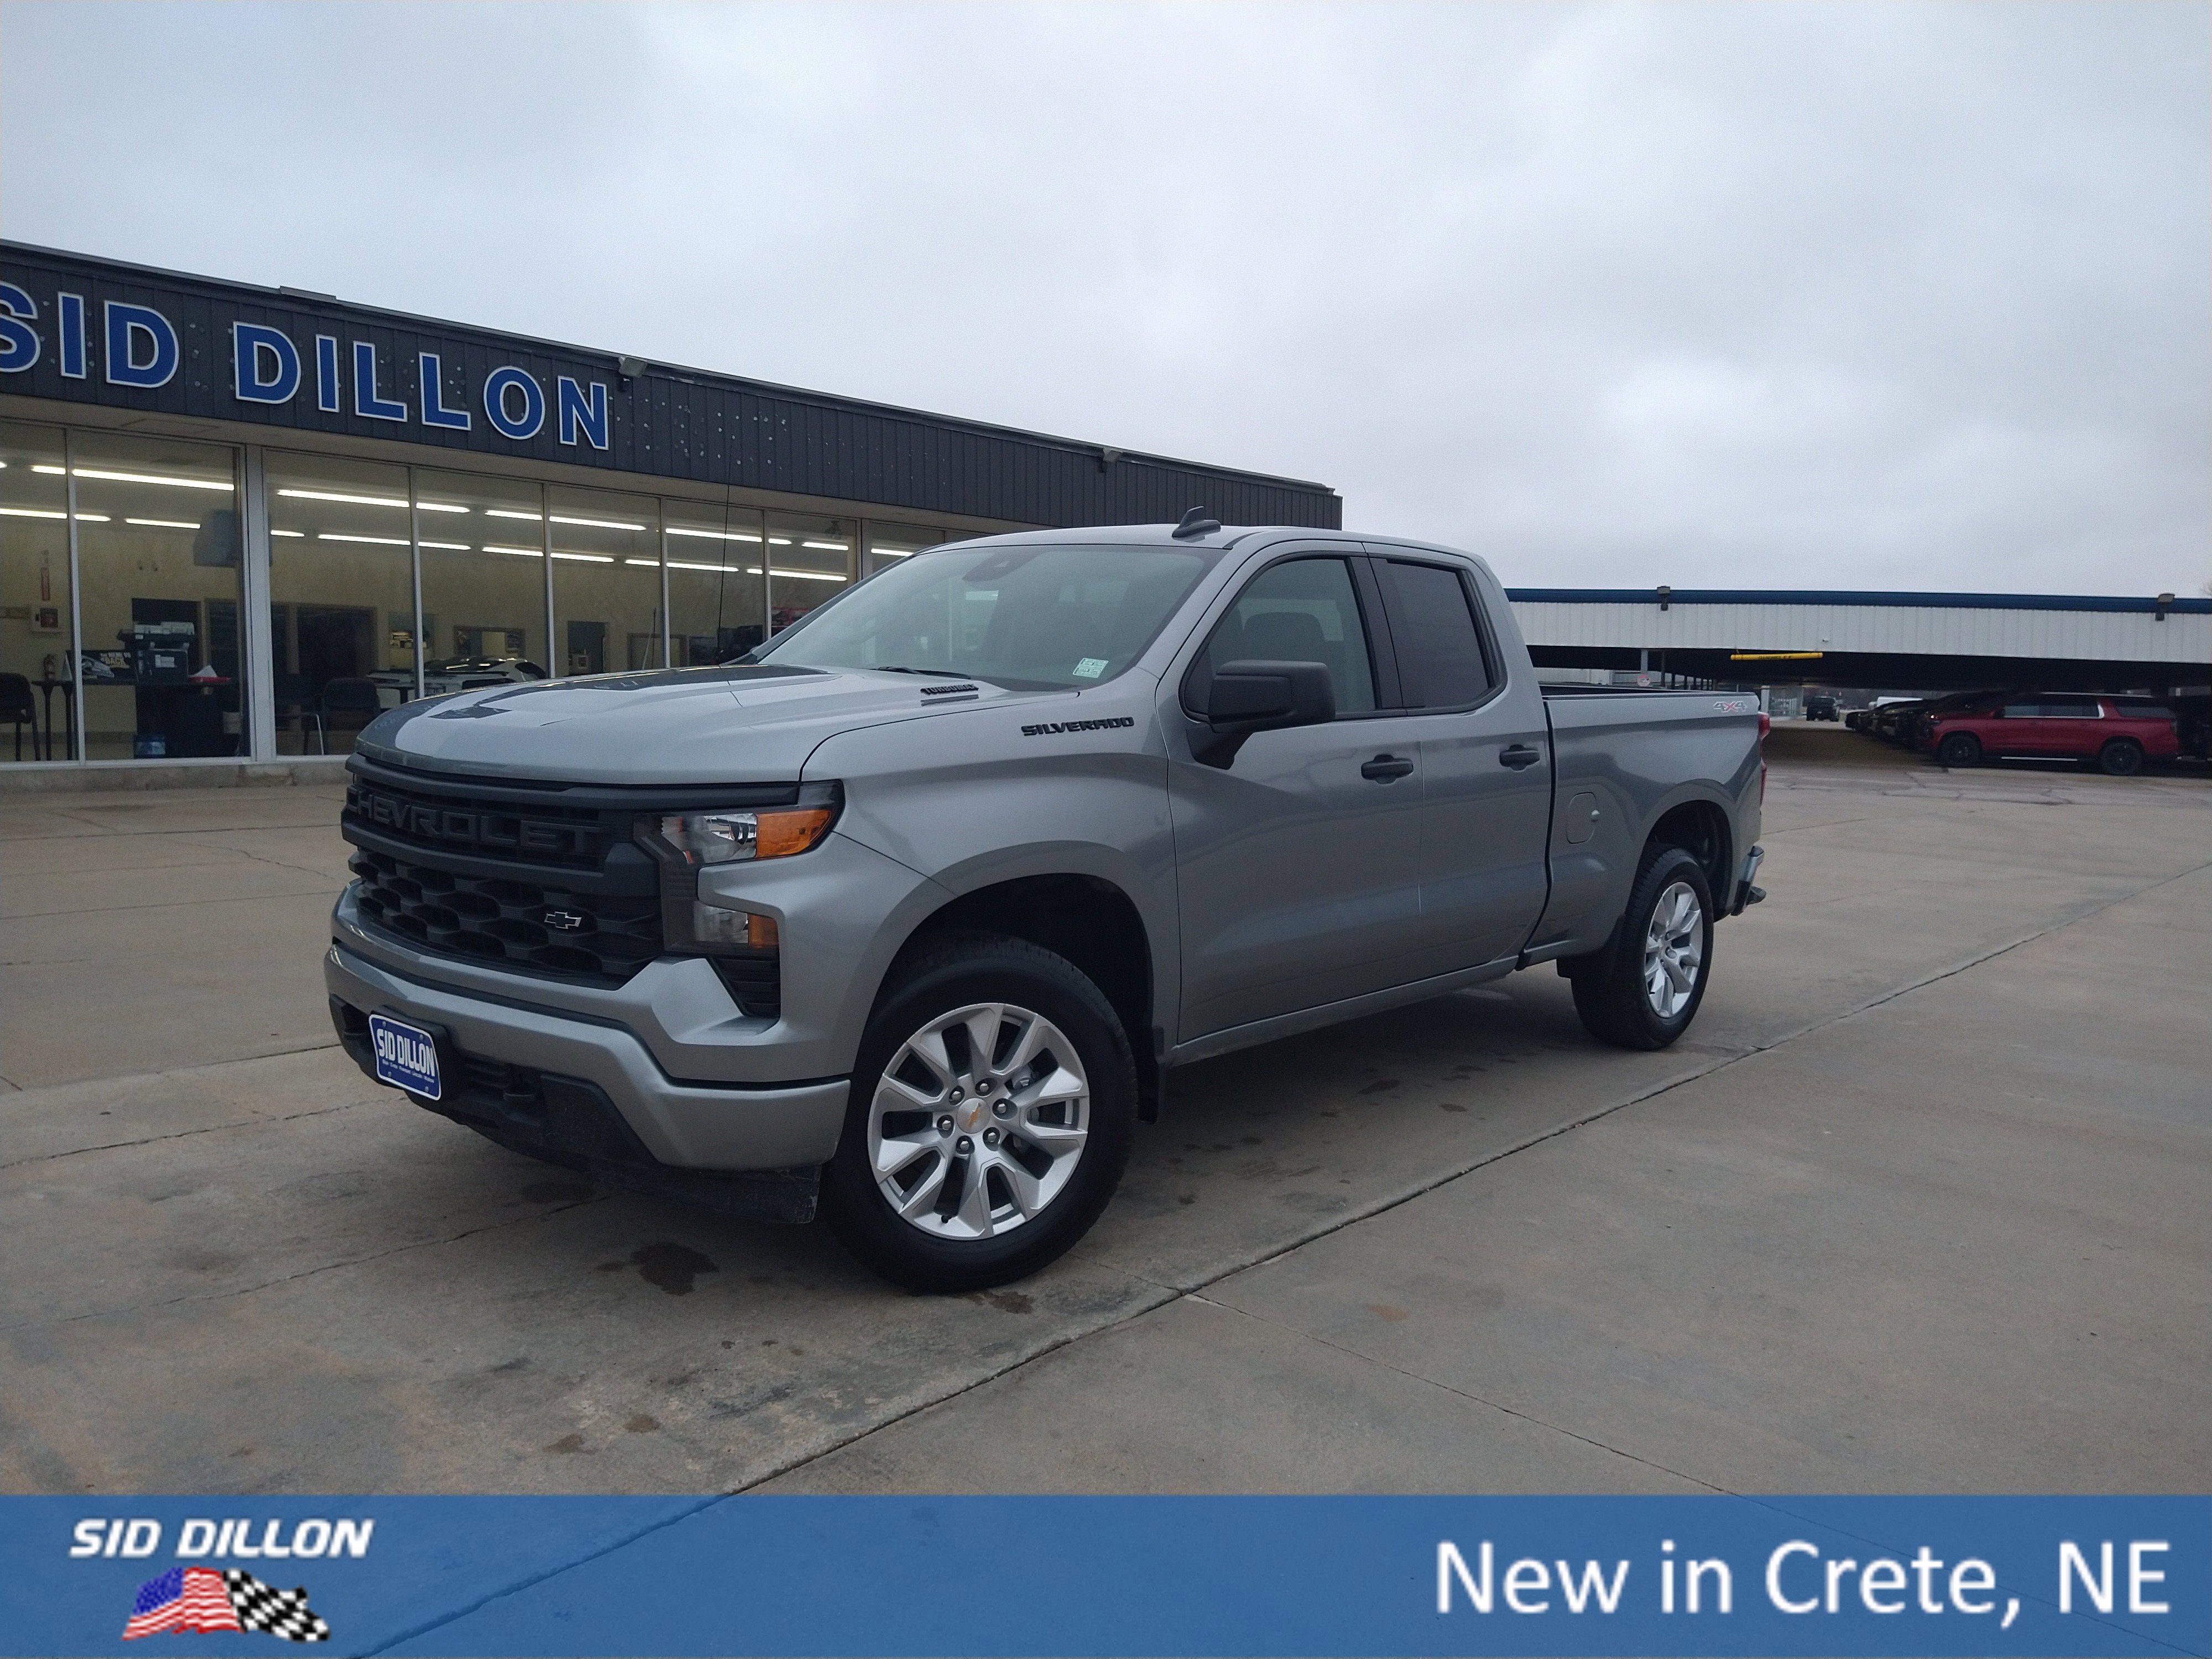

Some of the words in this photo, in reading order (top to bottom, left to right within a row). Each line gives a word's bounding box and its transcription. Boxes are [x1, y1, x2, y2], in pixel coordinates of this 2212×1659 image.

[0, 280, 180, 388] SID
[233, 321, 609, 450] DILLON
[1021, 717, 1134, 736] SILVERADO
[347, 784, 603, 854] CHEVROLET
[377, 1028, 395, 1061] SID
[397, 1035, 435, 1077] DILLON
